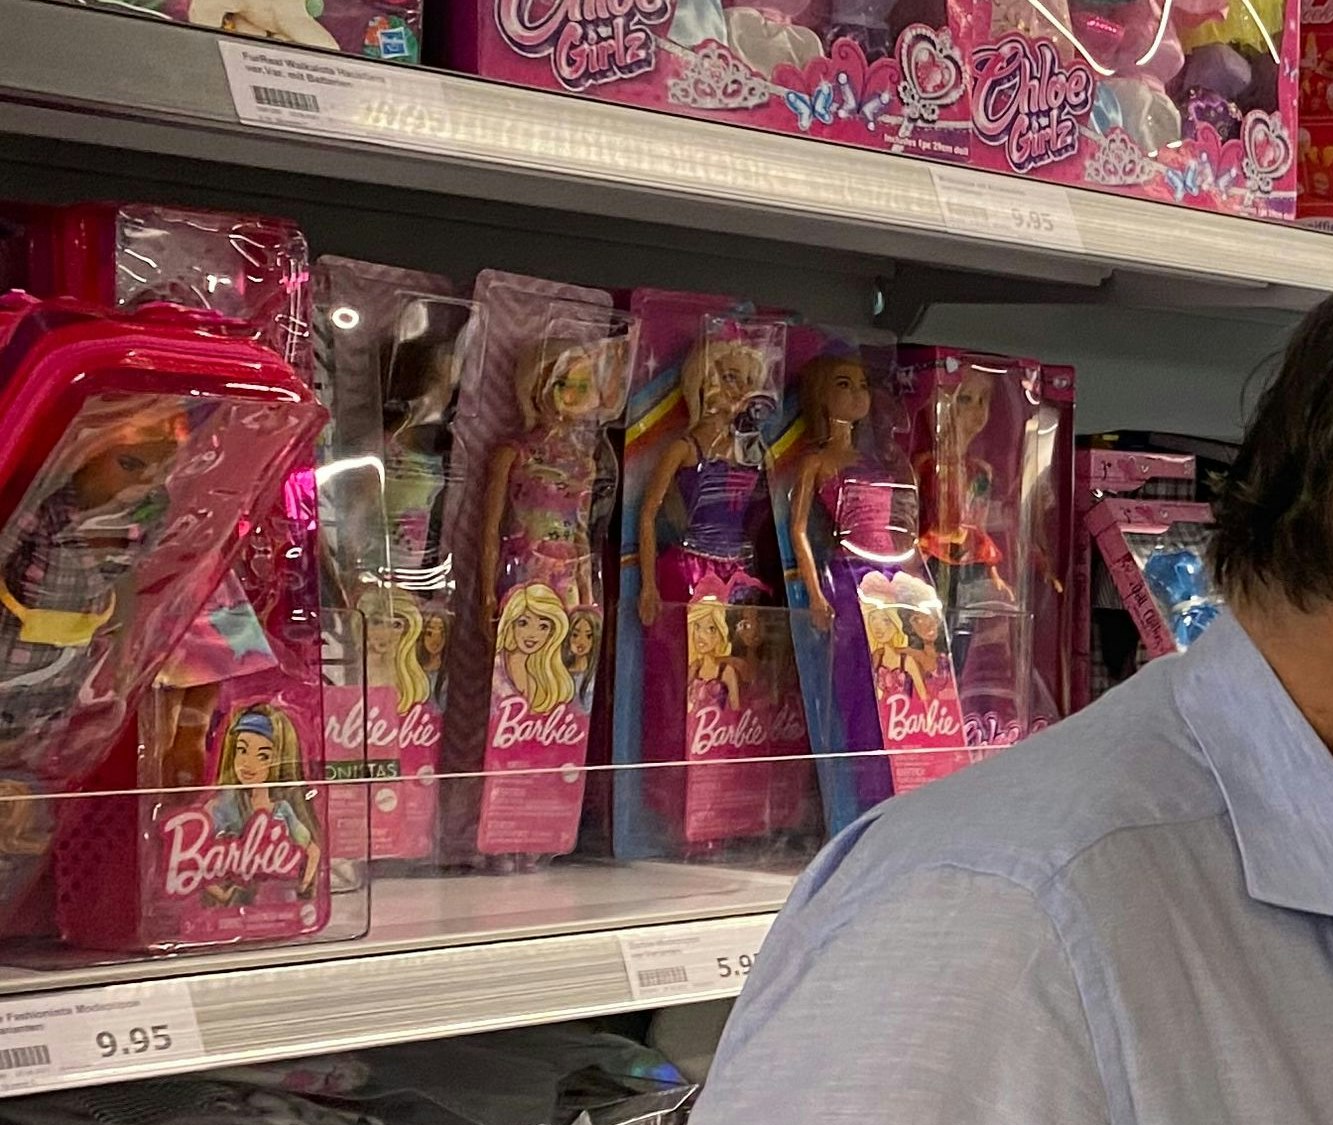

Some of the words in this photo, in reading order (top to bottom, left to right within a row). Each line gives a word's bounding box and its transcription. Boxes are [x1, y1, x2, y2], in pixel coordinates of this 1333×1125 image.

[553, 20, 649, 80] Girlz
[972, 37, 1092, 144] Chloe
[1008, 113, 1078, 164] Girlz
[1011, 208, 1055, 231] 9.95
[325, 697, 398, 749] rbie
[399, 704, 440, 748] bie
[492, 696, 586, 749] Barbie
[692, 708, 766, 755] Barbie
[888, 693, 960, 740] Barbie
[164, 813, 301, 895] Barbie
[95, 1024, 173, 1058] 9.95
